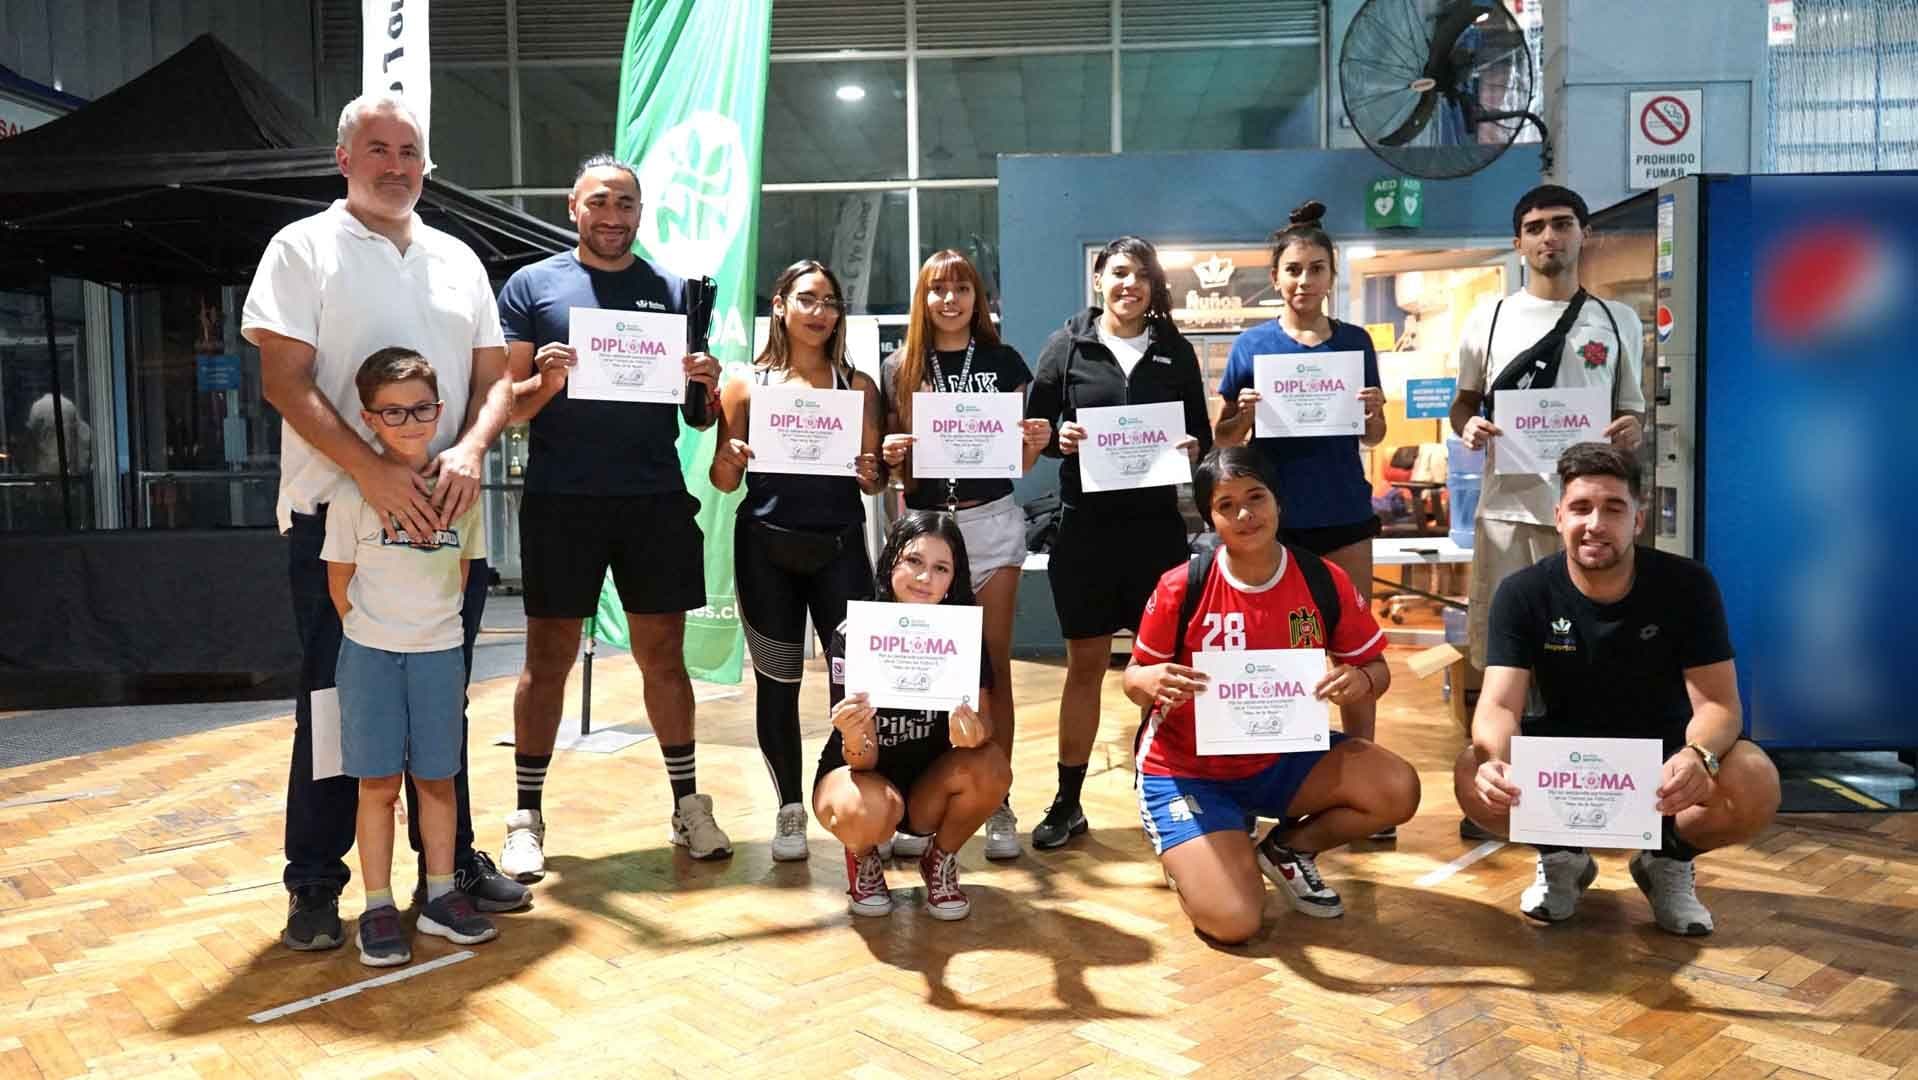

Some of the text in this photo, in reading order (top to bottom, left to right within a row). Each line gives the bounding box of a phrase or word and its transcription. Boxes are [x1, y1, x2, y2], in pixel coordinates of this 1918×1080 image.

[1636, 153, 1695, 165] PROHIBIDO
[1646, 167, 1685, 178] FUMAR
[1374, 180, 1397, 192] AED
[591, 337, 666, 355] DIPLOMA
[1274, 379, 1345, 393] DIPLOMA
[770, 414, 843, 430] DIPLOMA
[933, 420, 1004, 432] DIPLOMA
[1516, 415, 1590, 429] DIPLOMA
[1098, 430, 1168, 447] DIPLOMA
[1202, 612, 1246, 652] 28
[870, 635, 958, 655] DIPLOMA
[1219, 681, 1306, 699] DIPLOMA
[1538, 771, 1635, 790] DIPLOMA
